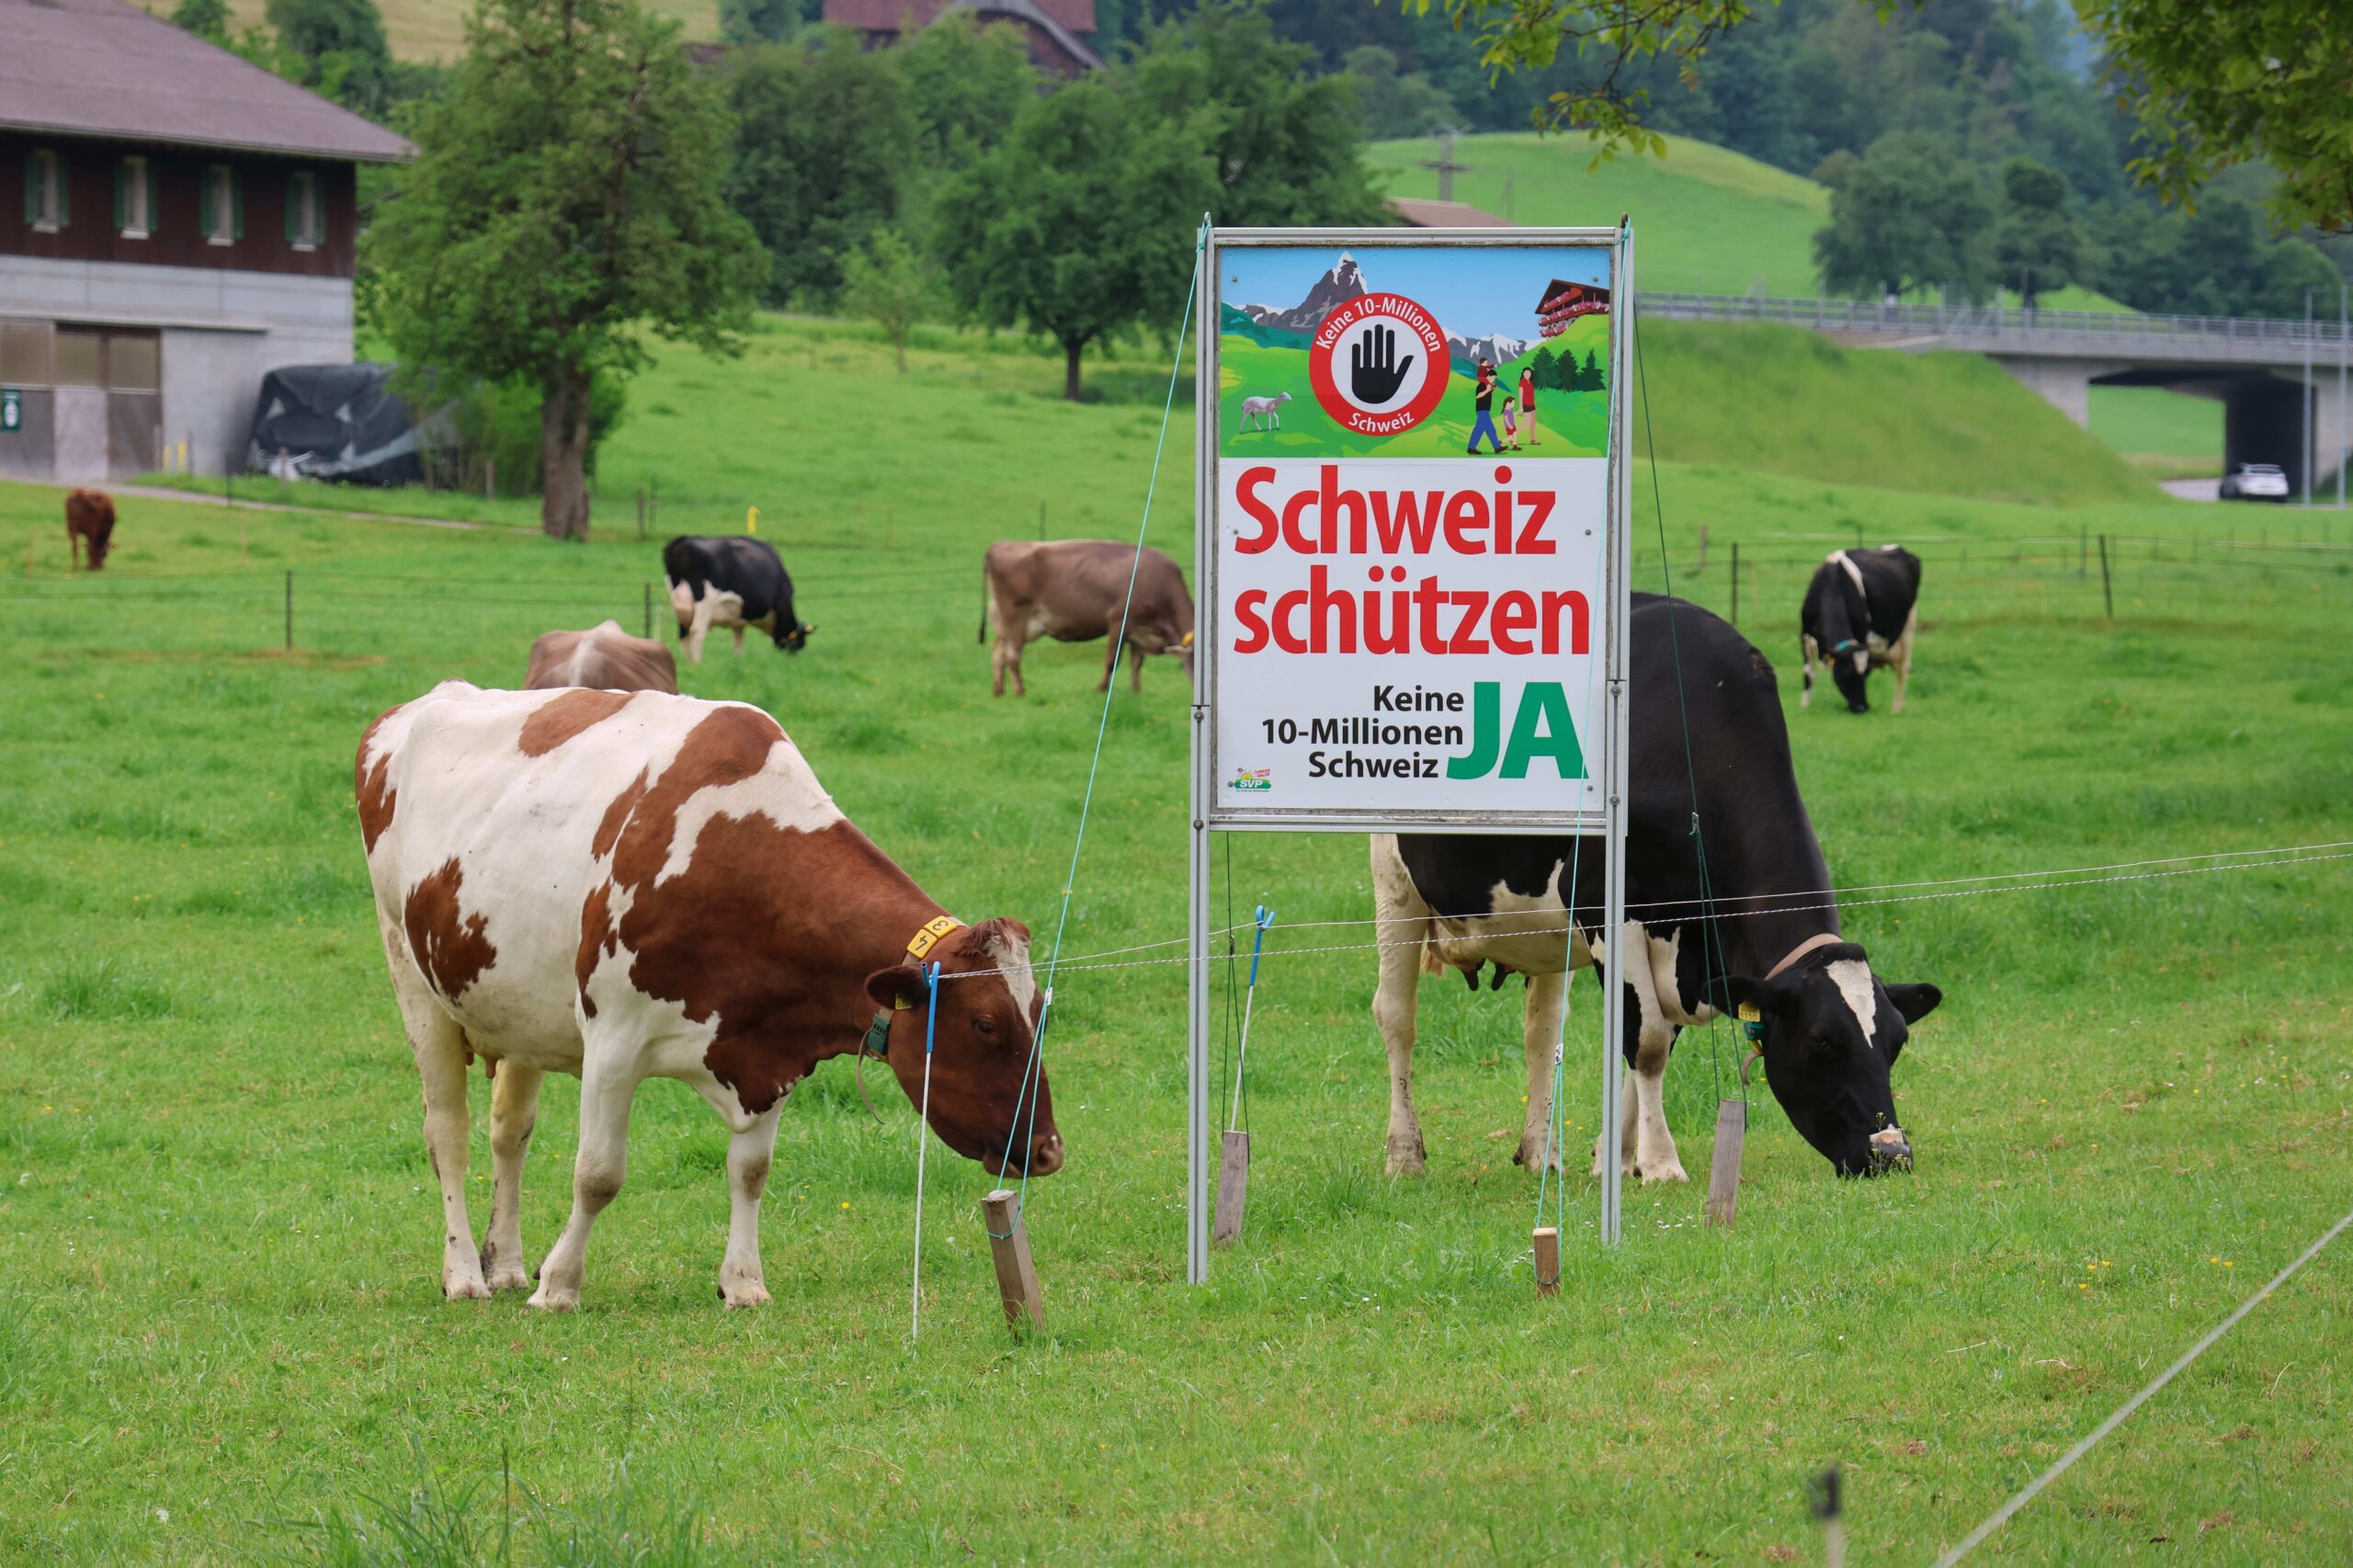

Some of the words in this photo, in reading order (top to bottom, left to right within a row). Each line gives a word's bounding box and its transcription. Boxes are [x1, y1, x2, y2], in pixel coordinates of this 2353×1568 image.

[1316, 311, 1354, 350] Keine
[1355, 297, 1441, 352] 10-Millionen
[1348, 412, 1414, 433] Schweiz
[1234, 464, 1557, 555] Schweiz
[1233, 563, 1590, 655] schützen
[1373, 685, 1464, 712] Keine
[1262, 717, 1463, 745] 10-Millionen
[1446, 681, 1589, 780] JA
[1308, 750, 1438, 778] Schweiz
[1240, 779, 1263, 789] SVP
